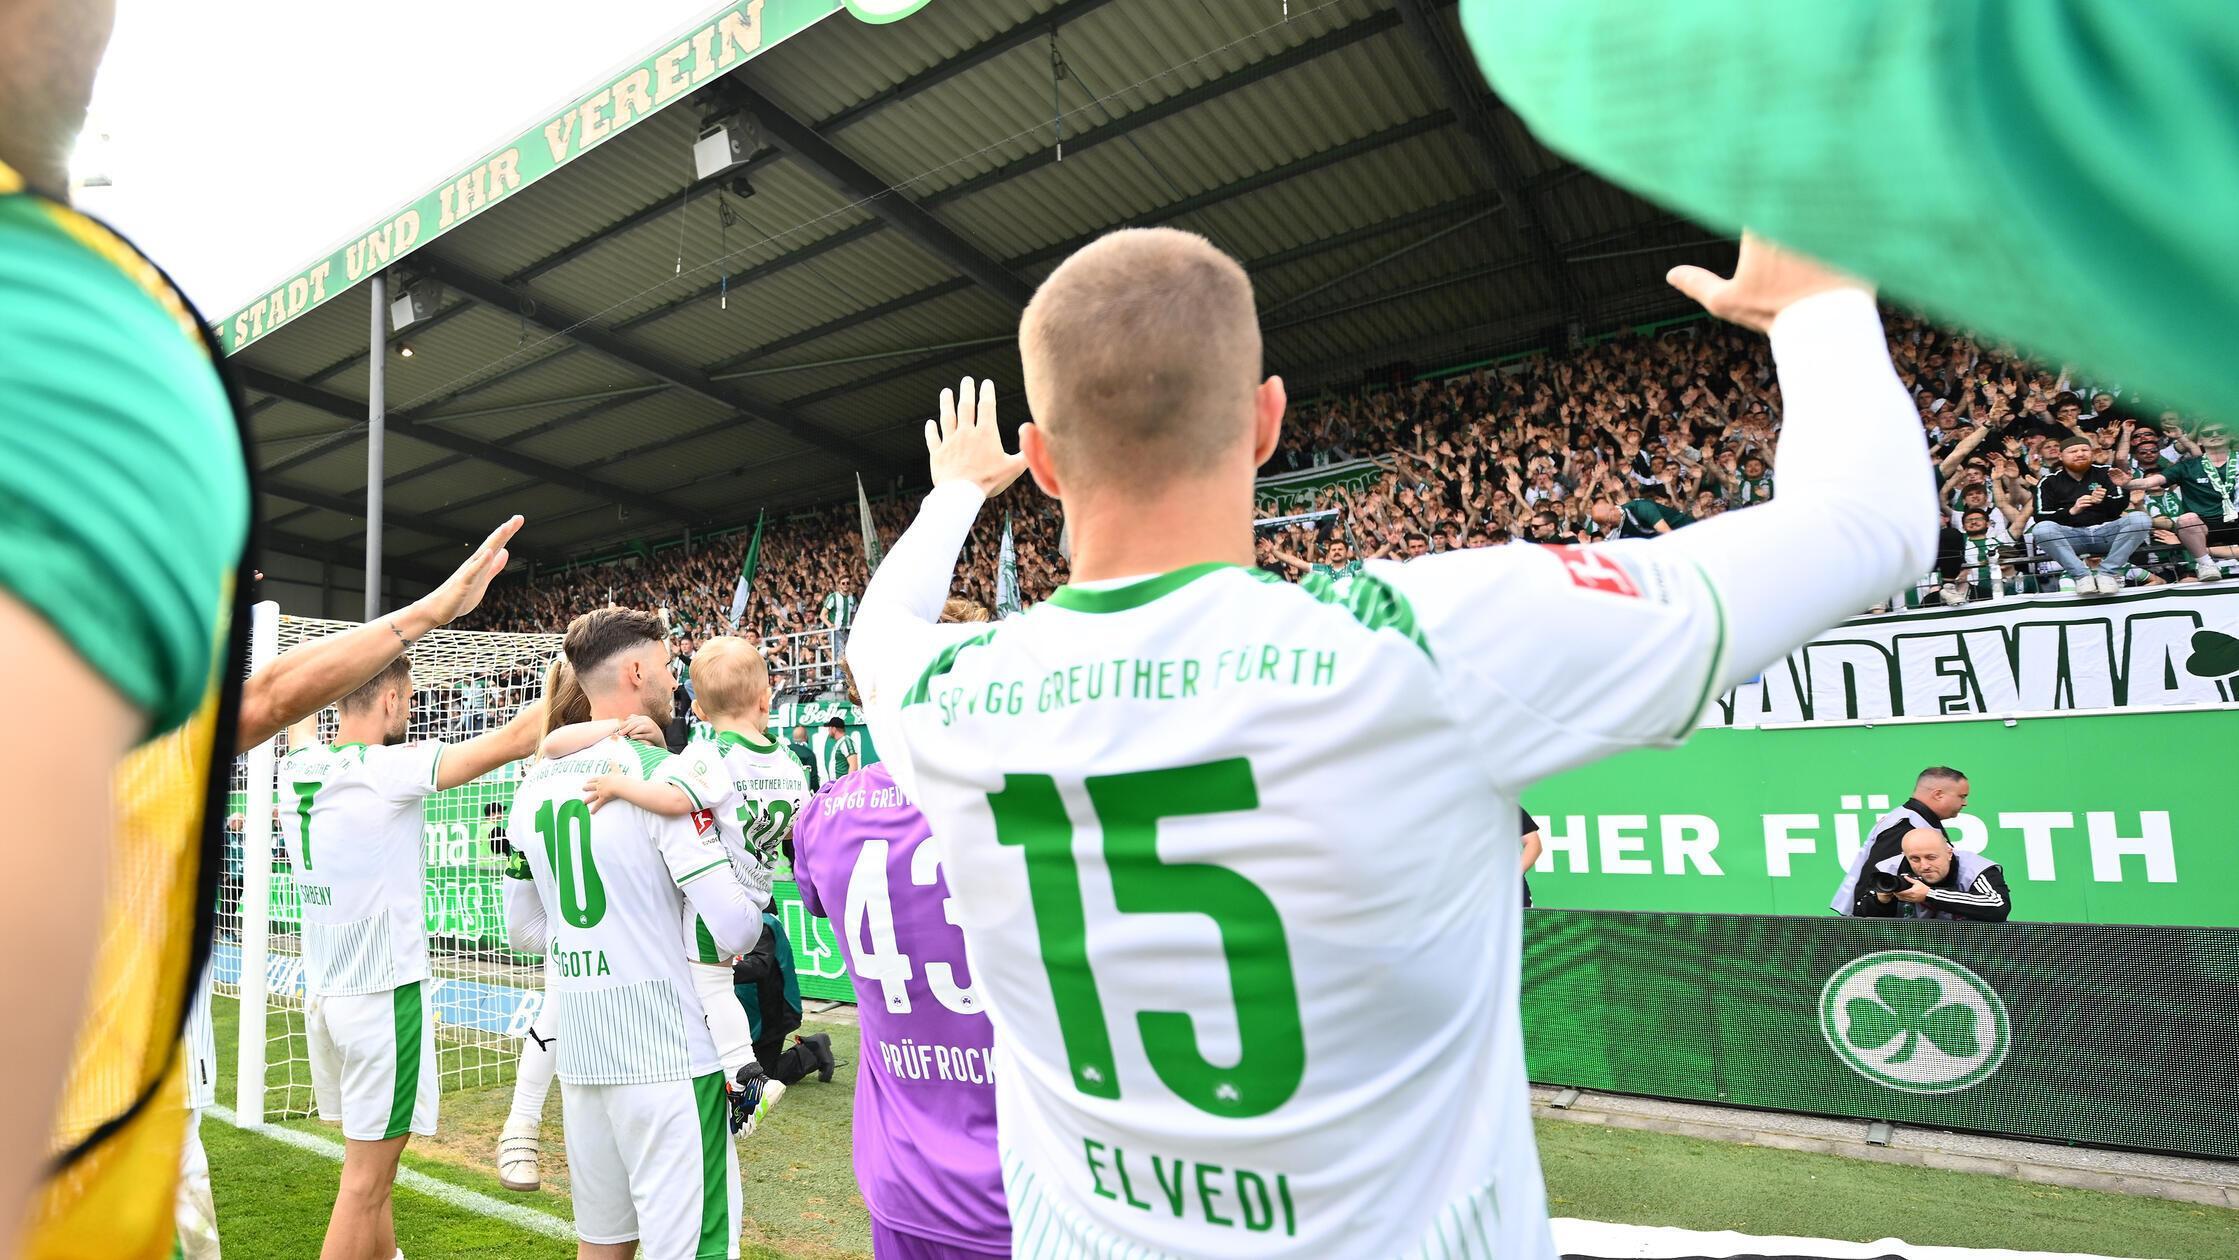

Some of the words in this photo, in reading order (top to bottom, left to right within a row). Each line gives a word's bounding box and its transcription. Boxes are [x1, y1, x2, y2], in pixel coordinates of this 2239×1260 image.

[234, 261, 330, 348] STADT
[345, 212, 420, 281] UND
[438, 147, 521, 229] IHR
[545, 0, 765, 164] VEREIN
[1037, 658, 1201, 714] GREUTHER
[1213, 643, 1337, 690] FÜRTH
[293, 782, 322, 871] 7
[534, 798, 607, 929] 10
[559, 950, 611, 977] GOTA
[985, 756, 1306, 1119] 15
[1082, 1137, 1297, 1238] ELVEDI
